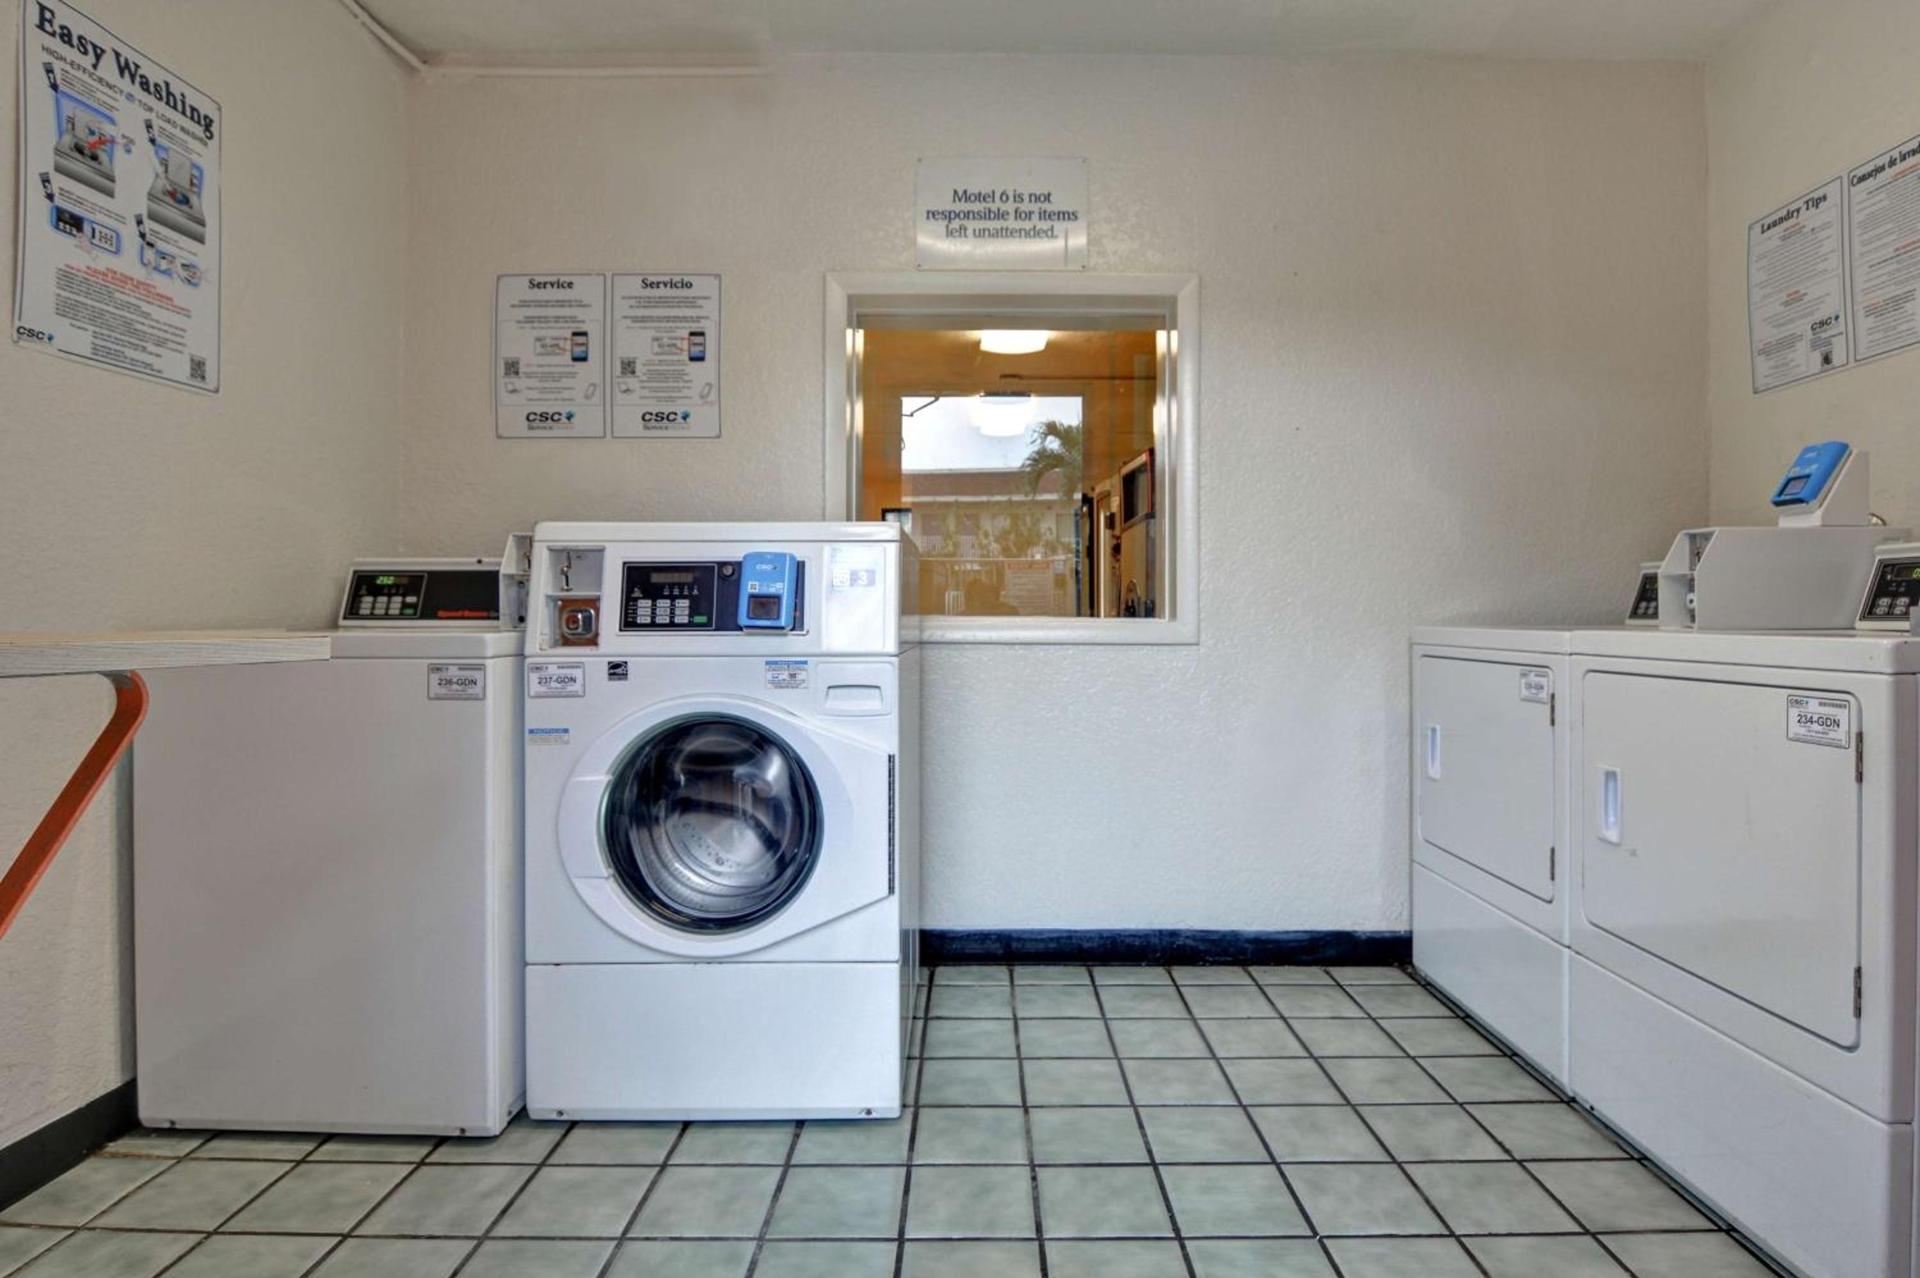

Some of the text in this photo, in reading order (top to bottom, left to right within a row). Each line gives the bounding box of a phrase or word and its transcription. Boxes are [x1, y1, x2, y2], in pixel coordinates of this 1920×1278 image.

[35, 1, 106, 71] Easy
[112, 47, 215, 140] Washing
[41, 43, 125, 95] HIGH-EFFICIENCY
[1850, 162, 1886, 188] Consejos
[1887, 156, 1898, 170] de
[952, 188, 1053, 204] Motel 6 is not
[926, 207, 1079, 223] responsible for items
[1760, 193, 1828, 235] Laundry Tips
[946, 224, 1059, 239] left unattended.
[528, 278, 574, 290] Service
[641, 278, 693, 290] Servicio
[1810, 317, 1833, 332] CSC
[16, 326, 46, 341] CSC
[526, 411, 563, 423] CSC
[641, 411, 679, 423] CSC
[538, 676, 577, 685] 237-GDN
[1797, 713, 1841, 728] 234-GDN
